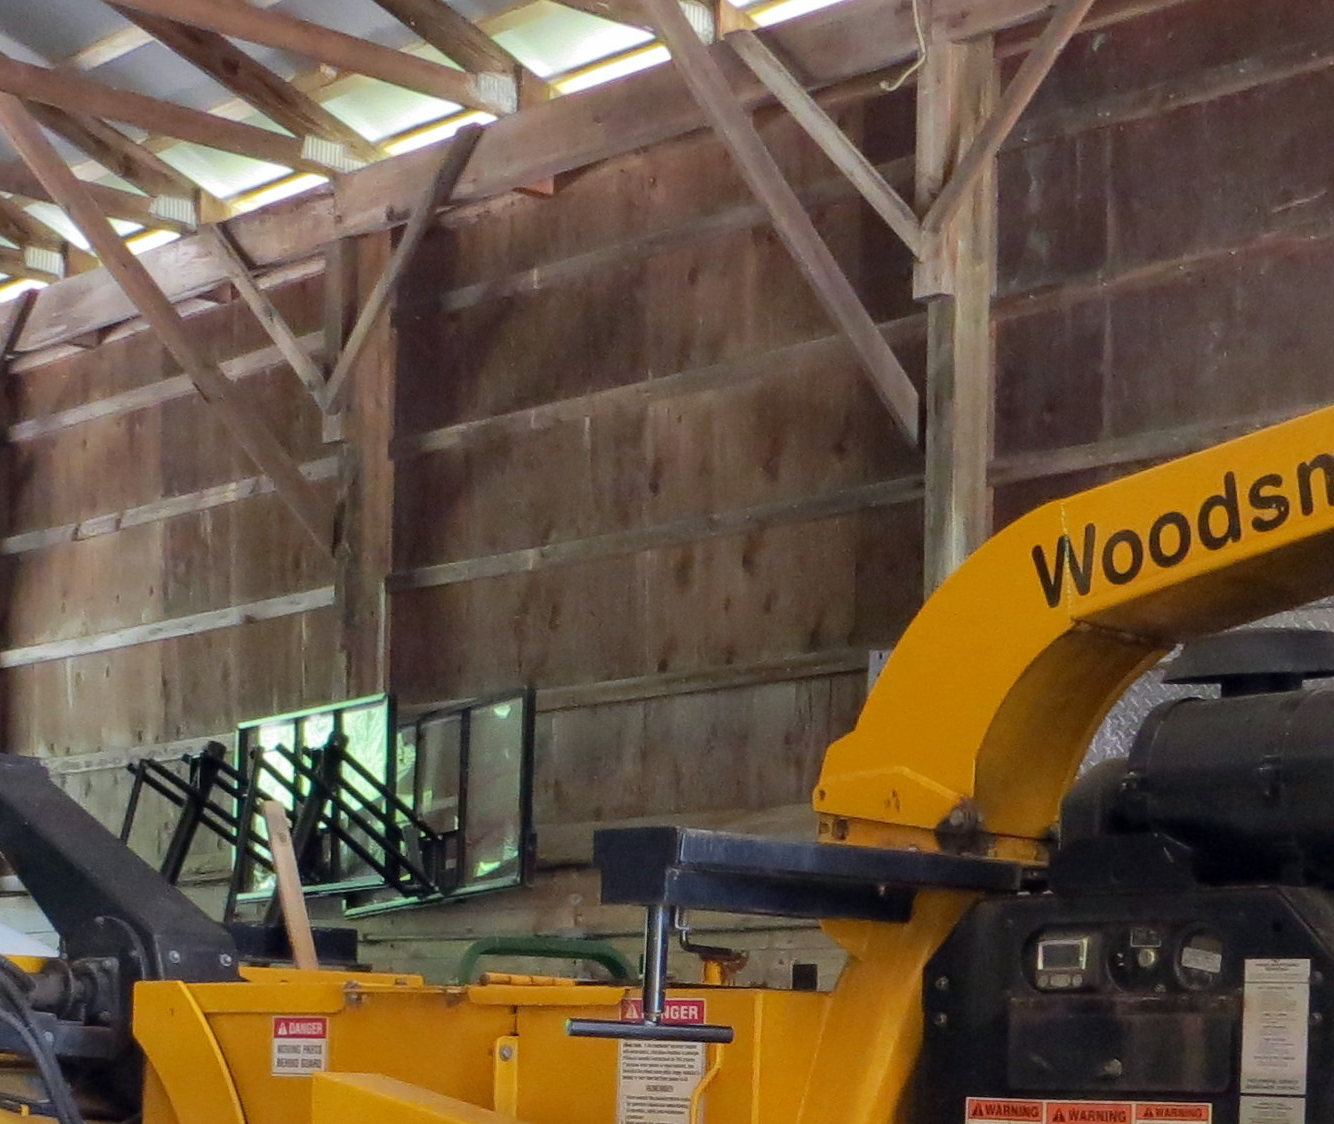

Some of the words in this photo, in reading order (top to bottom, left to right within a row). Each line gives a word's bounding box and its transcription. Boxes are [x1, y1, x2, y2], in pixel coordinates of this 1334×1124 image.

[289, 1022, 323, 1035] DANGER
[985, 1103, 1039, 1118] WARNING
[1068, 1108, 1127, 1123] WARNING
[1155, 1107, 1203, 1118] WARNING
